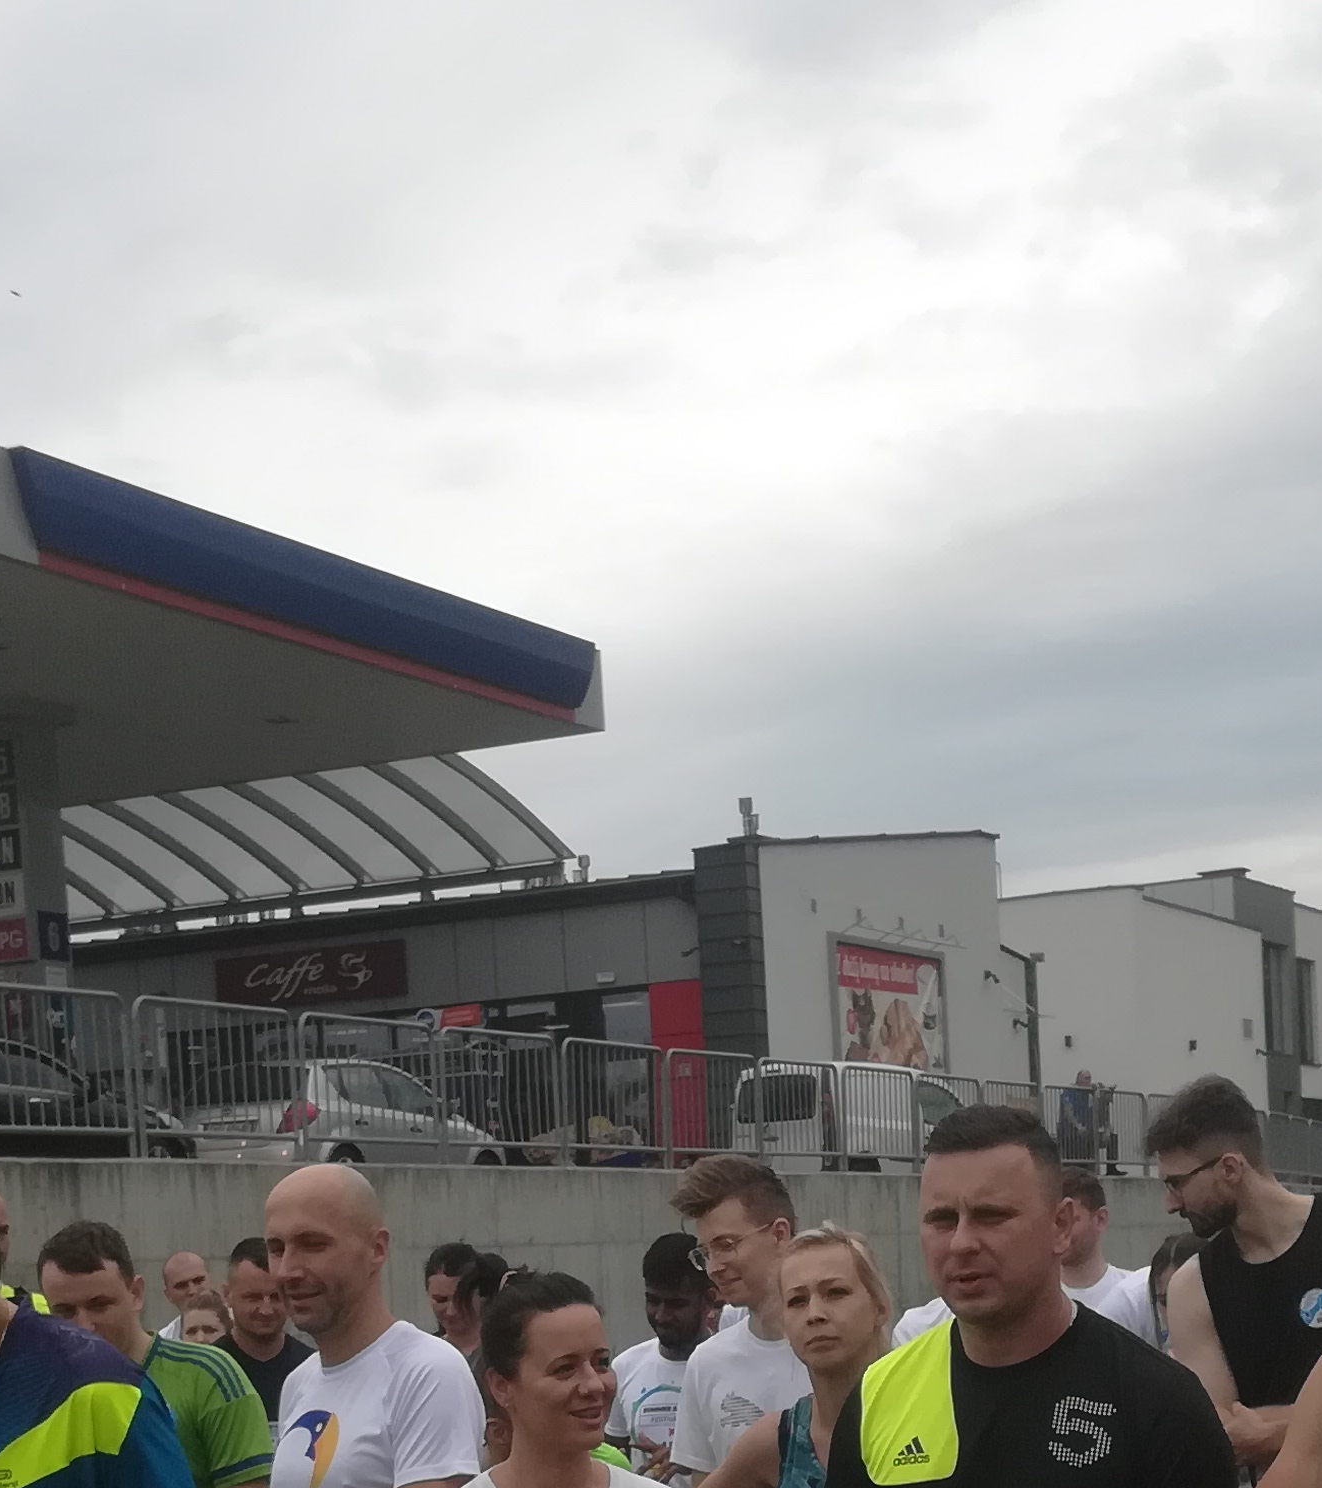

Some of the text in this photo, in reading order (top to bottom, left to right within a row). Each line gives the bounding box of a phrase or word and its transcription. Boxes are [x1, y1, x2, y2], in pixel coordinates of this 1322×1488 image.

[47, 920, 60, 952] 6
[1047, 1395, 1118, 1469] 5
[892, 1453, 931, 1468] adidas
